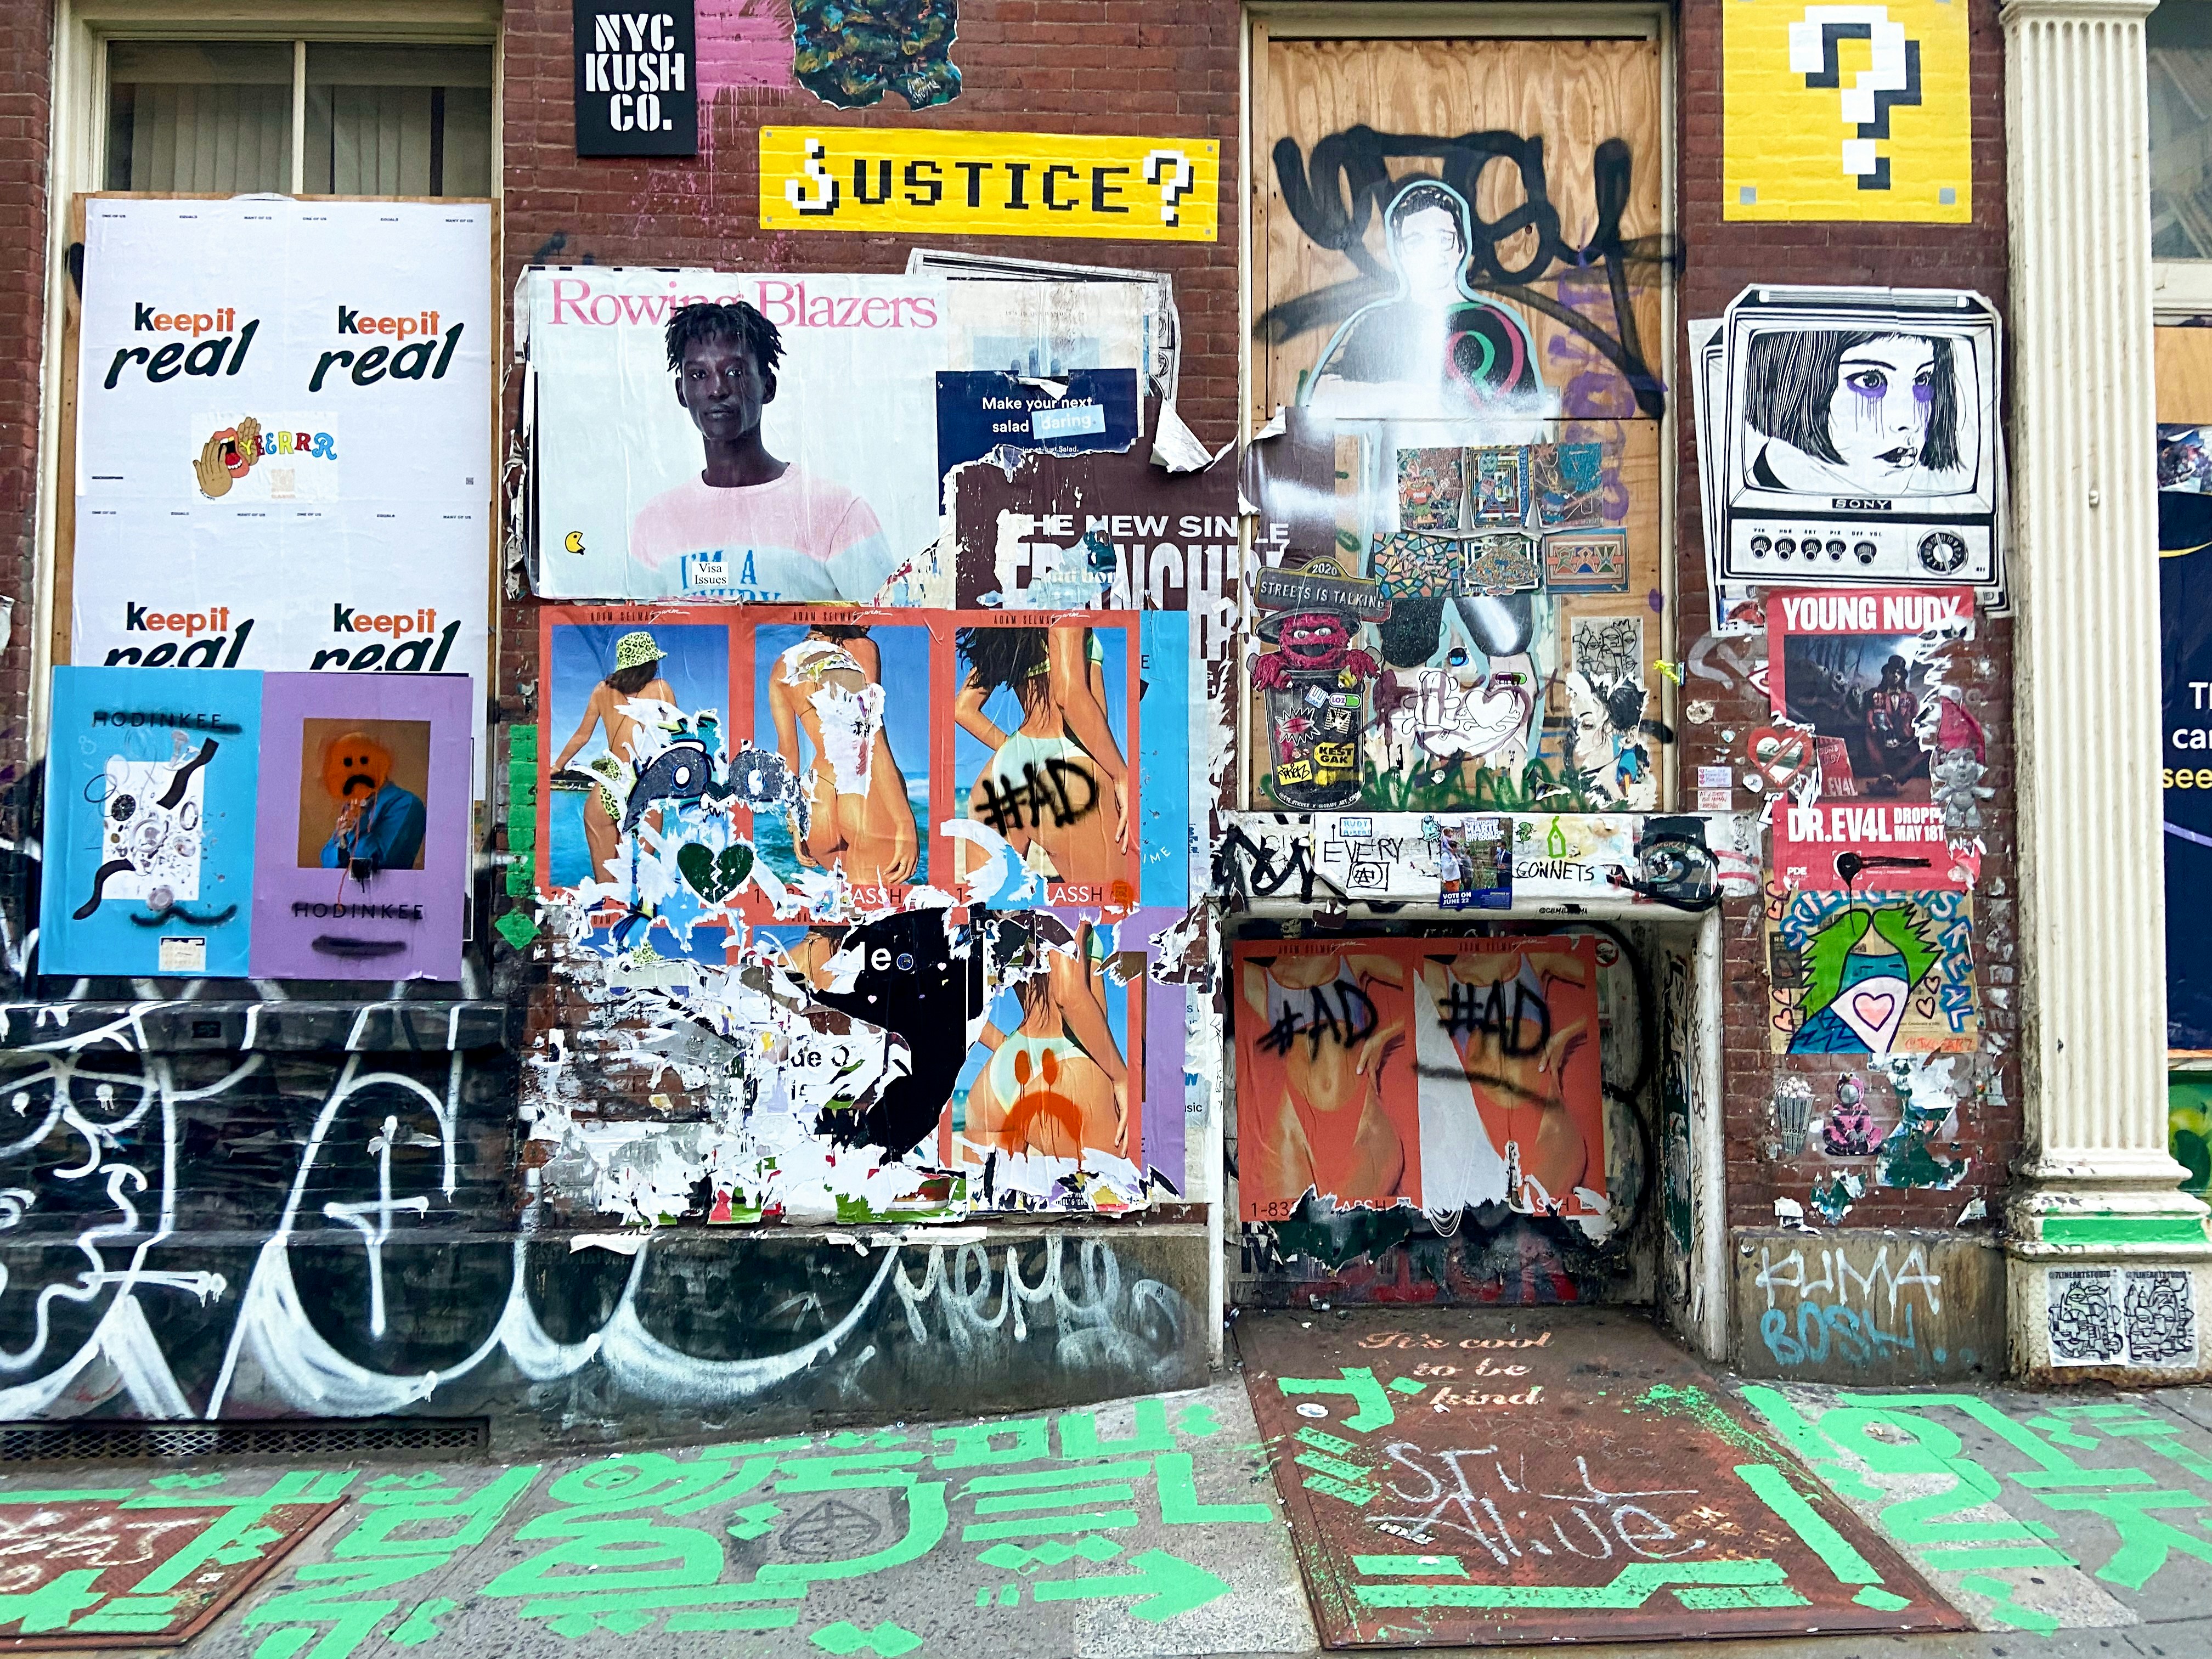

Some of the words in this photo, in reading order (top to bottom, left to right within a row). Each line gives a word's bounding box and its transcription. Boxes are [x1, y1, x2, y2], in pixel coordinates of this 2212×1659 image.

[595, 14, 674, 52] NYC
[585, 52, 685, 92] KUSH
[610, 93, 673, 132] CO.
[753, 280, 938, 328] Blazers
[104, 319, 259, 389] real
[309, 324, 464, 393] real
[982, 397, 1022, 410] Make
[1027, 397, 1057, 413] your
[1062, 396, 1093, 408] next
[992, 420, 1029, 433] salad
[1835, 499, 1889, 510] SONY
[1025, 515, 1075, 536] HE
[698, 563, 722, 573] Visa
[1312, 563, 1338, 577] 2020
[695, 574, 726, 585] Issues
[1261, 580, 1312, 601] STREETS
[1316, 587, 1328, 602] IS
[1334, 590, 1384, 609] TALKING
[590, 612, 613, 622] ADAM
[793, 612, 816, 622] ADAM
[994, 615, 1017, 624] ADAM
[1782, 597, 1877, 631] YOUNG
[1883, 596, 1960, 630] NUDY
[2188, 681, 2212, 710] T
[93, 712, 222, 729] HODINKEE
[2172, 728, 2212, 749] ca
[1319, 746, 1353, 756] KEST
[1819, 744, 1839, 755] OUNG
[1321, 755, 1347, 764] GAK
[975, 758, 1099, 837] #AD
[1464, 823, 1499, 833] MARTE
[1787, 808, 1893, 843] DR.EV4L
[1894, 825, 1921, 842] MAY
[1923, 825, 1946, 842] 18T
[1324, 837, 1404, 865] EVERY
[1787, 867, 1807, 876] PDE
[295, 902, 424, 920] HODINKEE
[1257, 979, 1378, 1059] #AD
[1437, 979, 1550, 1058] #AD
